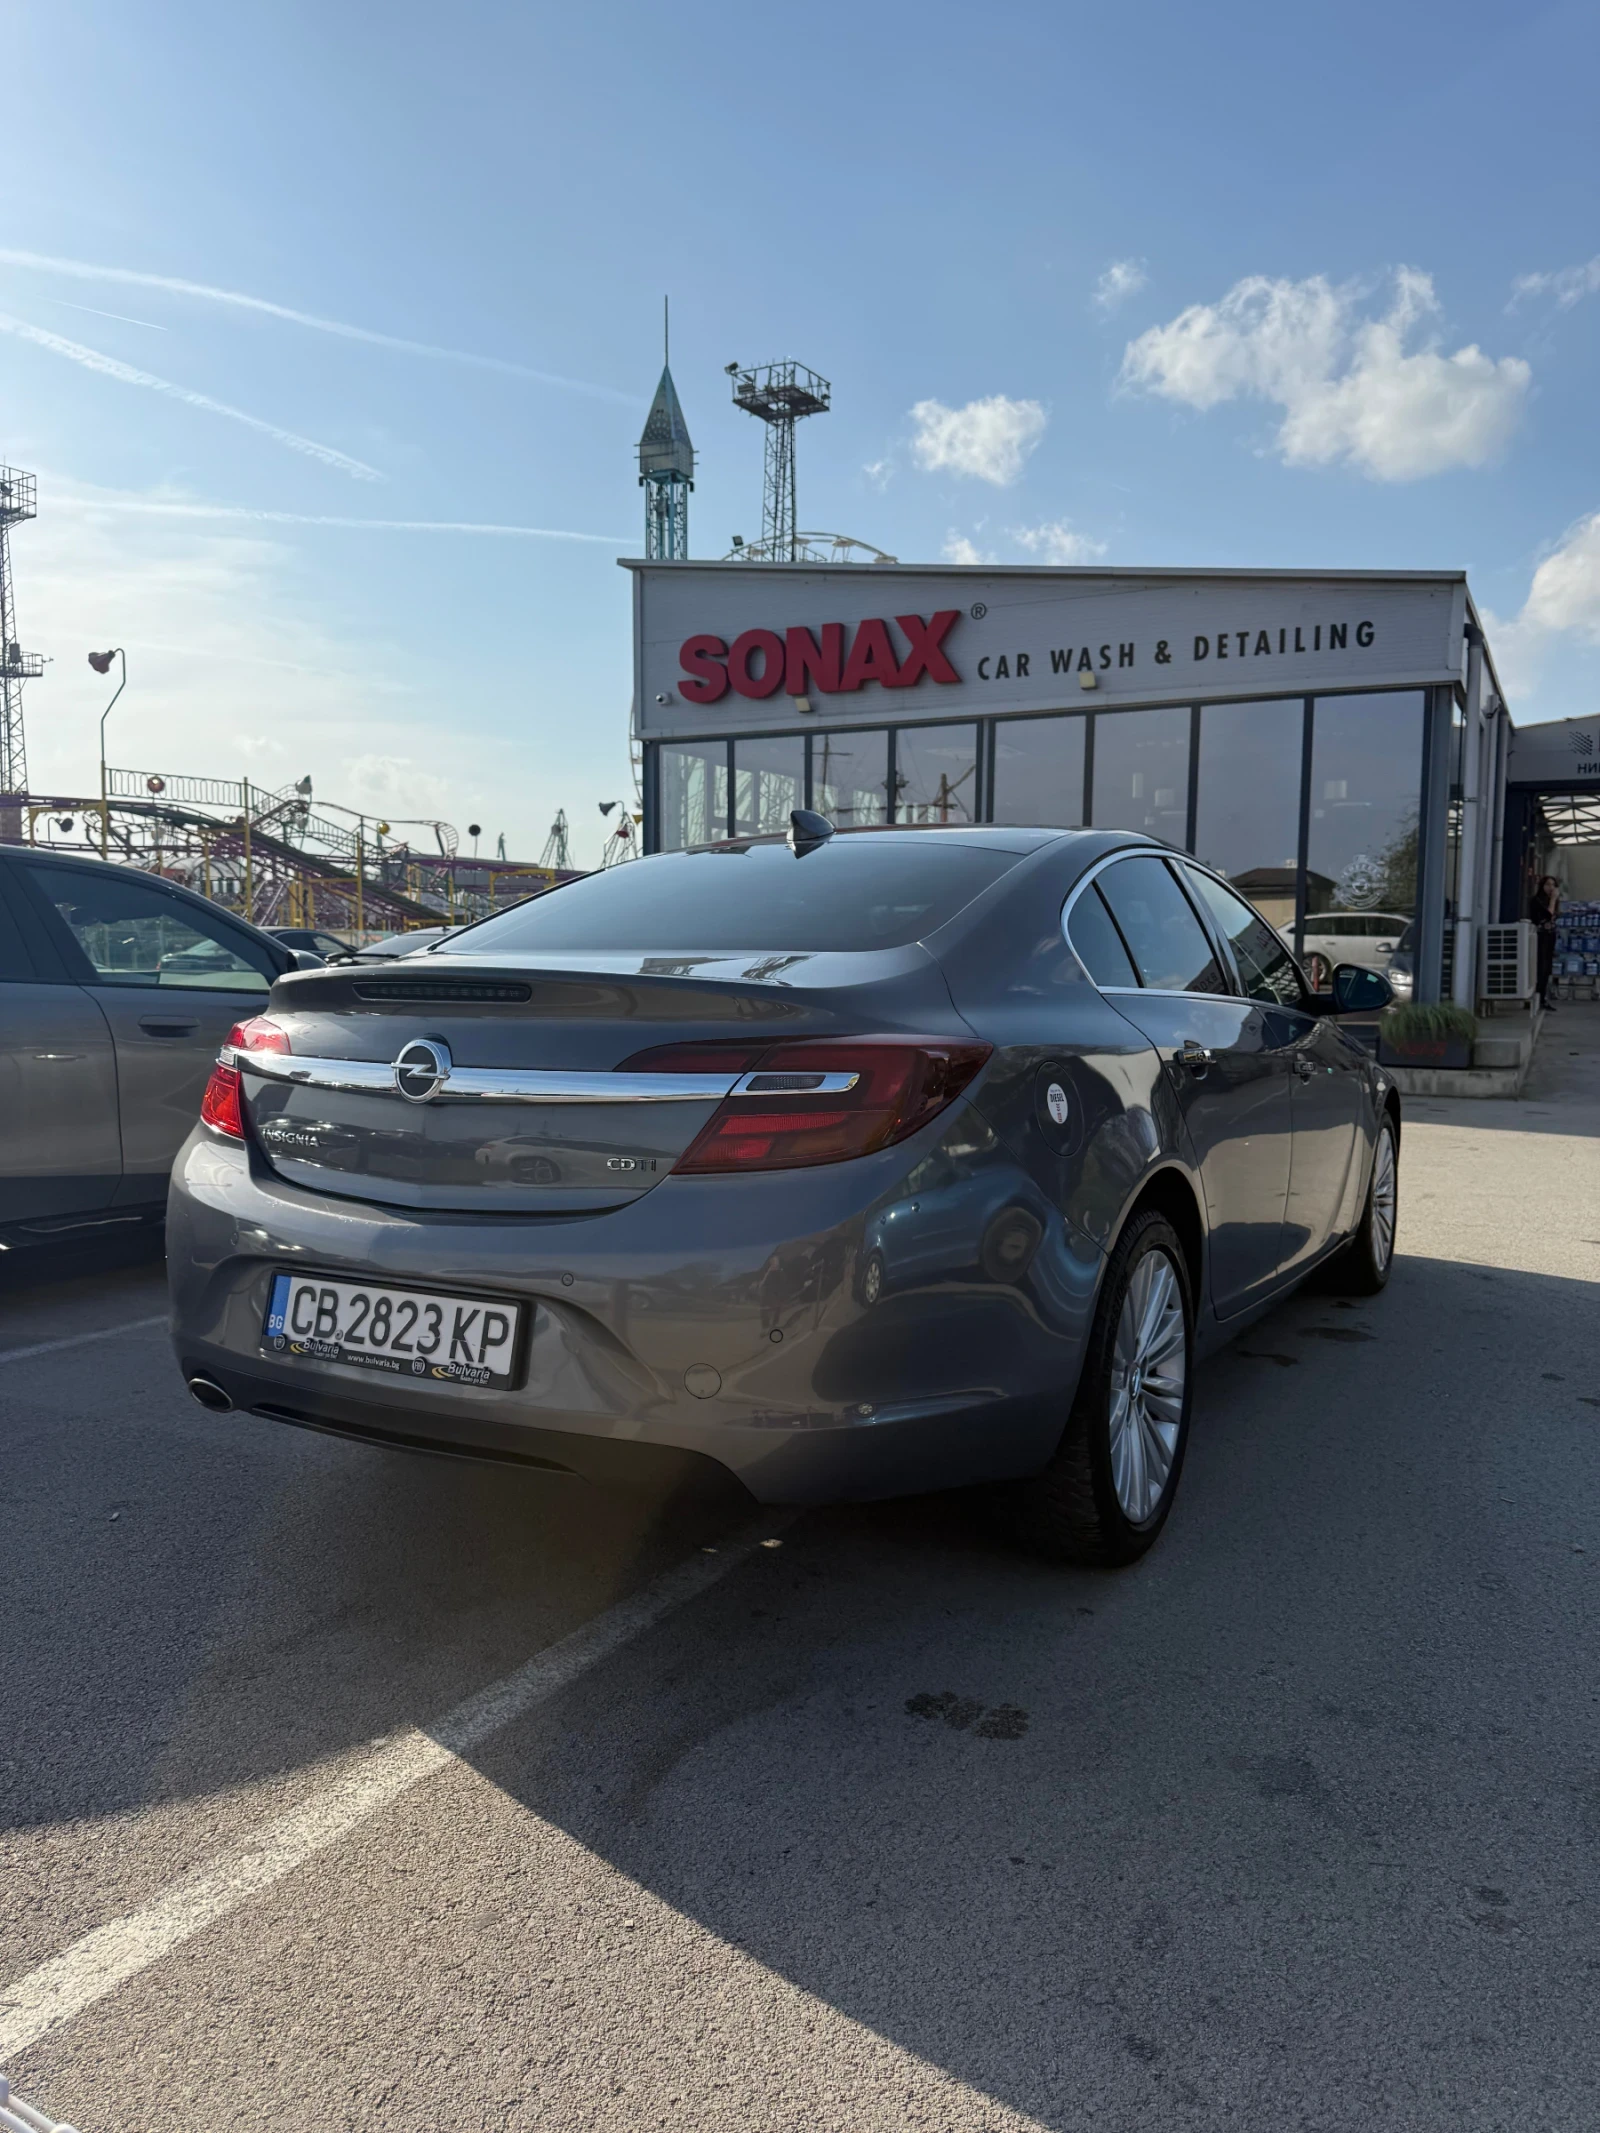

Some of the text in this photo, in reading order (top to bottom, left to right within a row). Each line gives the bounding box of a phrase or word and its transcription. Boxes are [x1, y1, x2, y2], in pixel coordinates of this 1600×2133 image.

[678, 609, 963, 704] SONAX
[977, 620, 1376, 682] CAR WASH & DETAILING
[1577, 762, 1600, 774] НИ
[261, 1128, 320, 1147] INSIGNIA
[606, 1157, 657, 1172] CDTI
[269, 1314, 284, 1330] BG
[303, 1338, 340, 1354] Bulvaria
[347, 1354, 400, 1371] www.bulvaria.bg
[448, 1361, 491, 1379] Bulvaria
